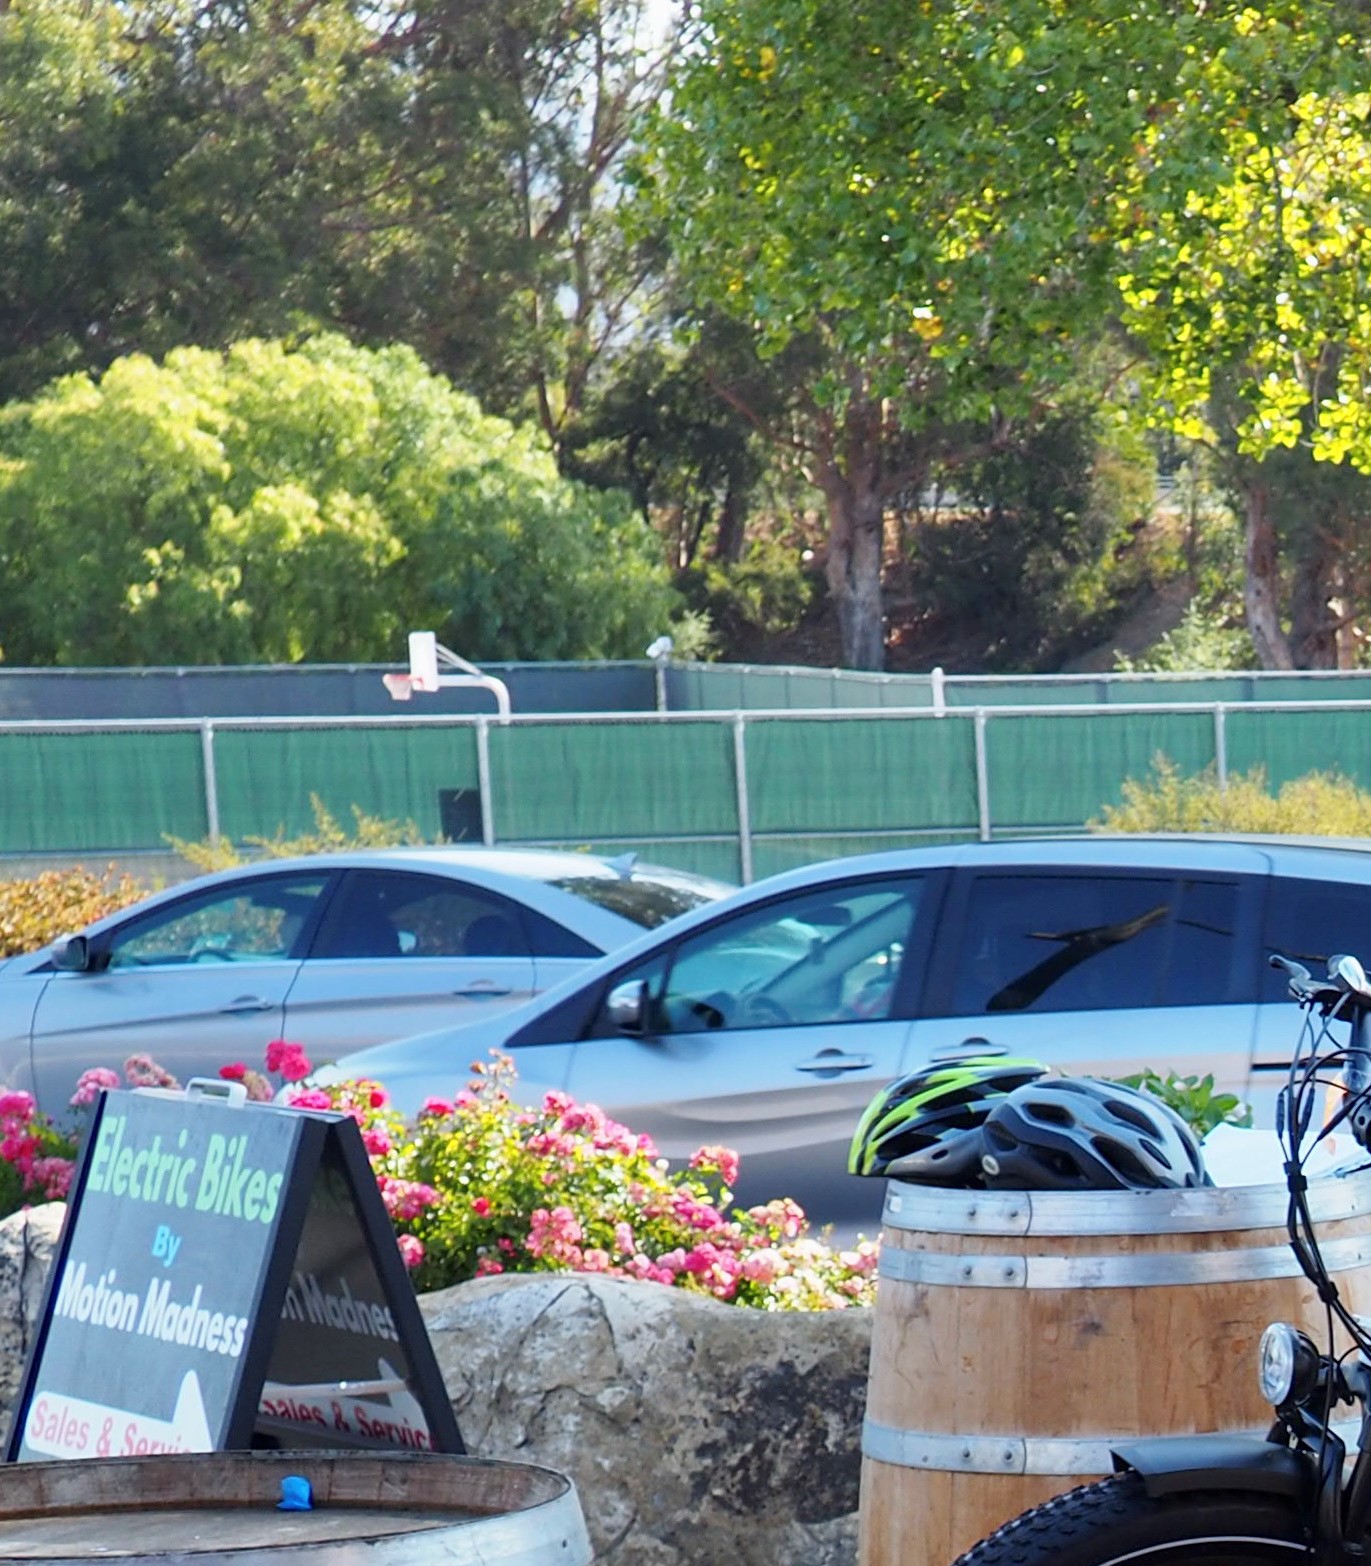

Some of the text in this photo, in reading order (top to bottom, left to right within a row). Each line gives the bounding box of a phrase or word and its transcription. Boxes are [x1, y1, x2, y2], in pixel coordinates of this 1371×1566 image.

[87, 1115, 196, 1211] Electric
[196, 1133, 284, 1224] Bikes
[151, 1225, 183, 1267] By
[54, 1261, 139, 1332] Motion
[138, 1277, 249, 1358] Madness
[295, 1271, 399, 1342] Madnes
[31, 1398, 91, 1451] Sales
[96, 1416, 114, 1458] &
